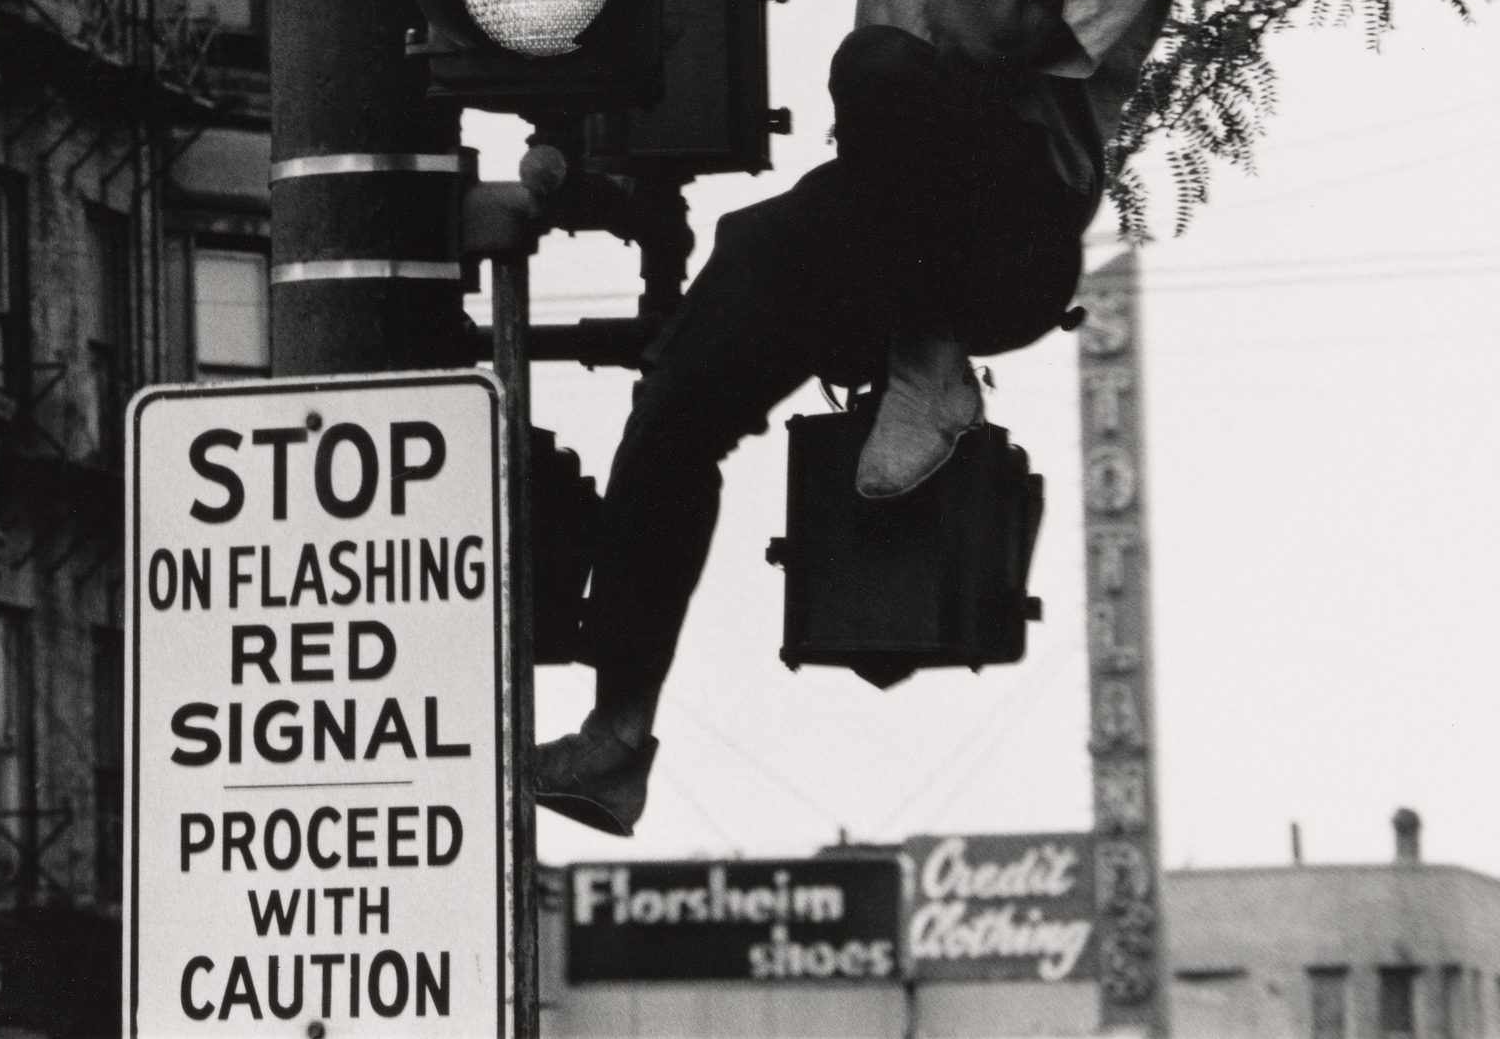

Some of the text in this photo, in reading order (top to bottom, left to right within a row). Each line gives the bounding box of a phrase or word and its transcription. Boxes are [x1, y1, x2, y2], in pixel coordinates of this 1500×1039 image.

[189, 421, 446, 524] STOP
[149, 535, 485, 611] ON FLASHING
[232, 621, 396, 684] RED
[171, 697, 471, 767] SIGNAL
[181, 806, 463, 872] PROCEED
[922, 836, 1074, 900] Credit
[248, 887, 389, 936] WITH
[574, 868, 843, 923] Florsheim
[750, 924, 893, 977] shoes
[910, 899, 1091, 980] Clothing
[181, 950, 449, 1020] CAUTION
